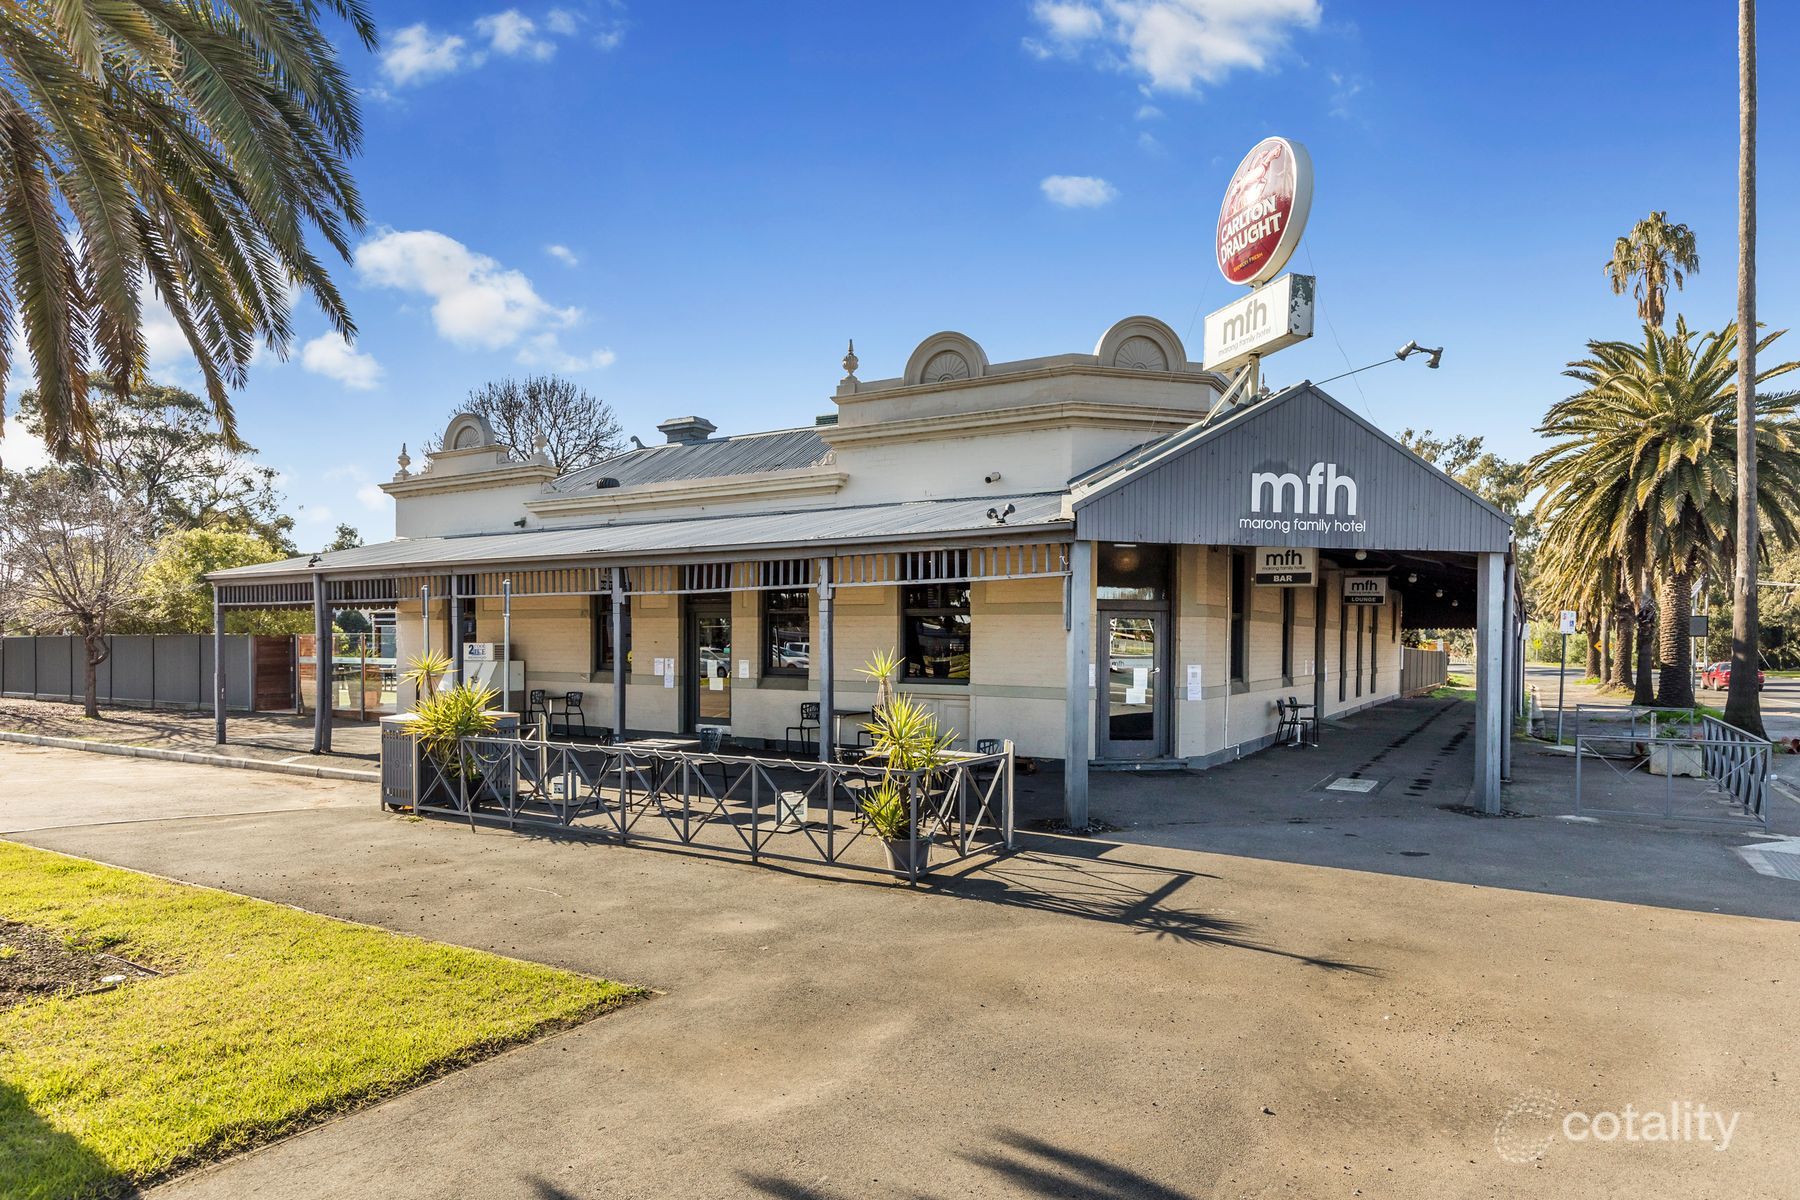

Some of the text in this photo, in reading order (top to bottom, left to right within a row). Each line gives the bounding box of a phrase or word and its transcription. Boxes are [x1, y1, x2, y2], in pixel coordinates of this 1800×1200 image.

[1220, 211, 1282, 266] DRAUGHT
[1221, 195, 1277, 243] CARLTON
[1222, 298, 1267, 345] mfh
[1251, 462, 1357, 516] mfh
[1239, 518, 1367, 534] marong family hotel
[1265, 549, 1303, 566] mfh
[1351, 579, 1378, 591] mfh
